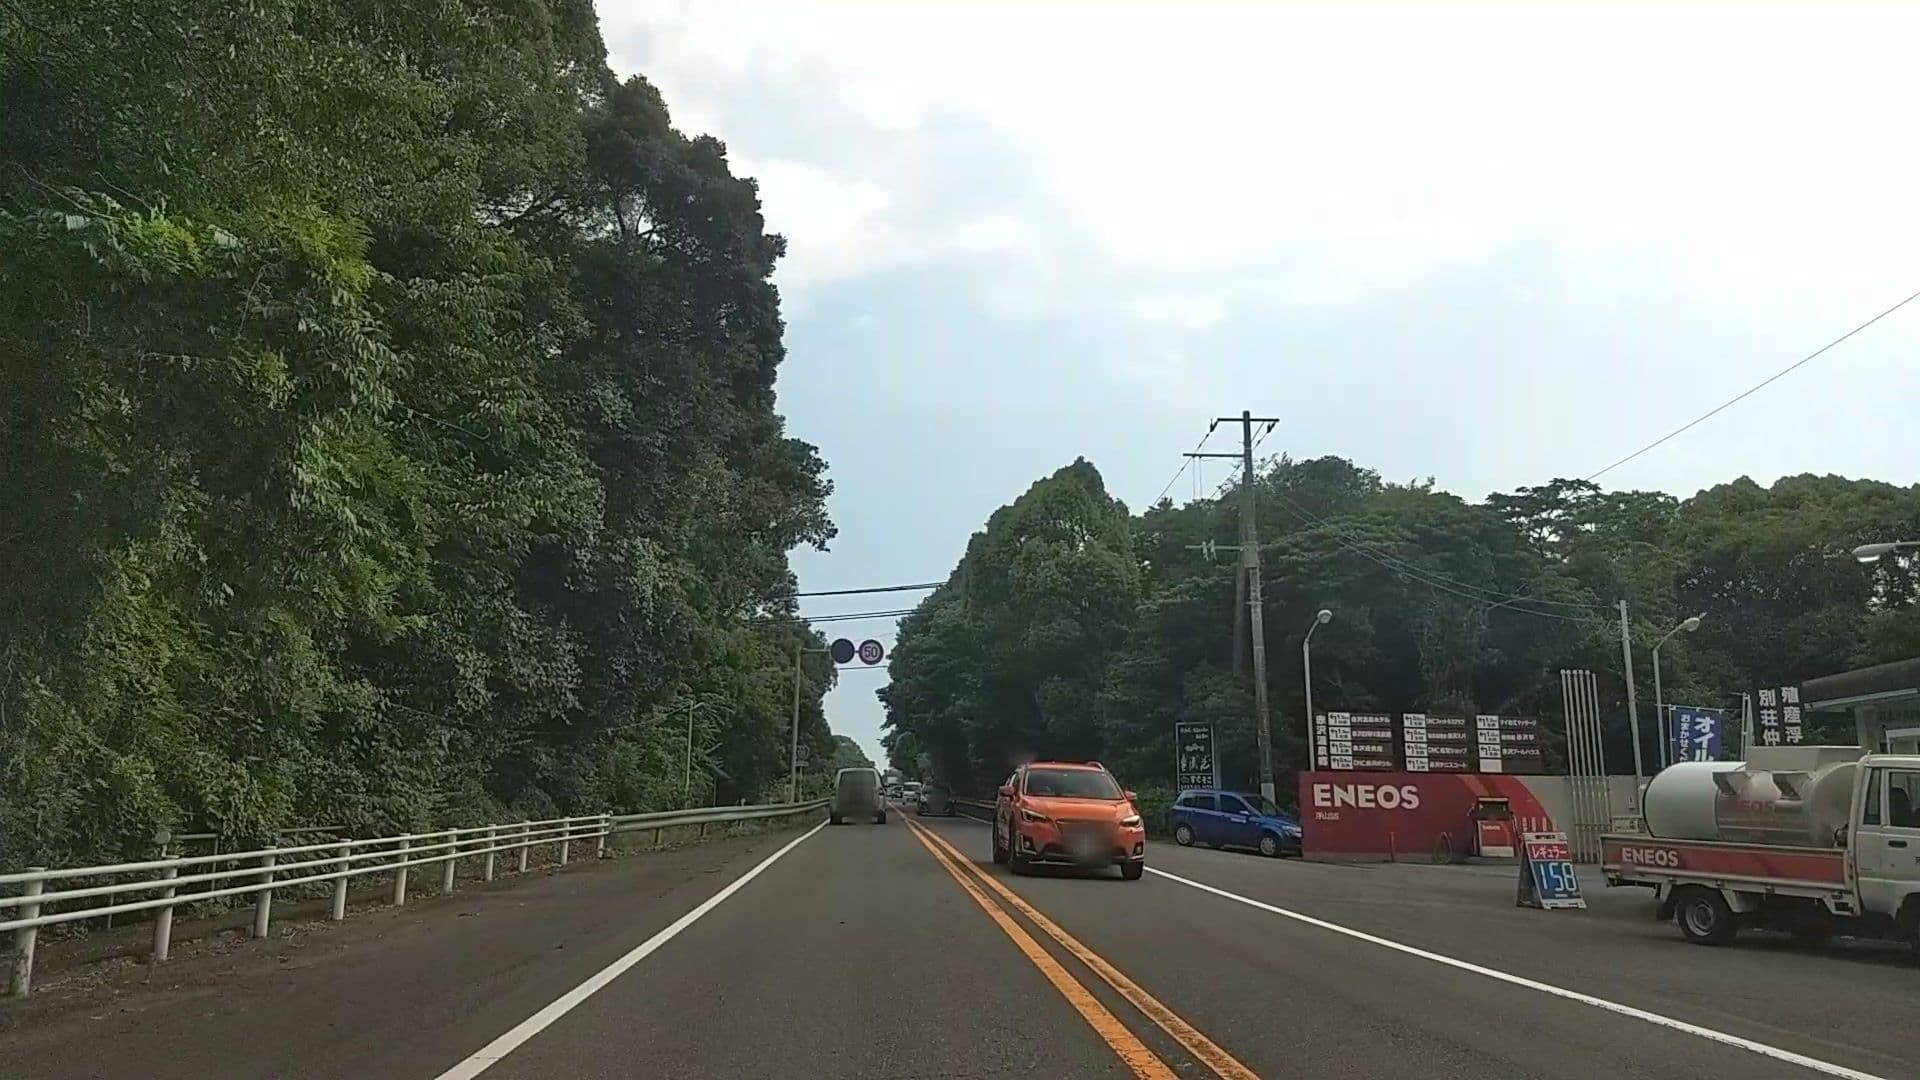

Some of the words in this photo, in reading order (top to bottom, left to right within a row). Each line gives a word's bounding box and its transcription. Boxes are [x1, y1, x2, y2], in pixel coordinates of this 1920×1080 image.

[864, 645, 878, 658] 50
[1313, 783, 1420, 810] ENEOS
[1532, 845, 1568, 859] レギュラー
[1622, 847, 1679, 867] ENEOS
[1540, 862, 1578, 892] 158
